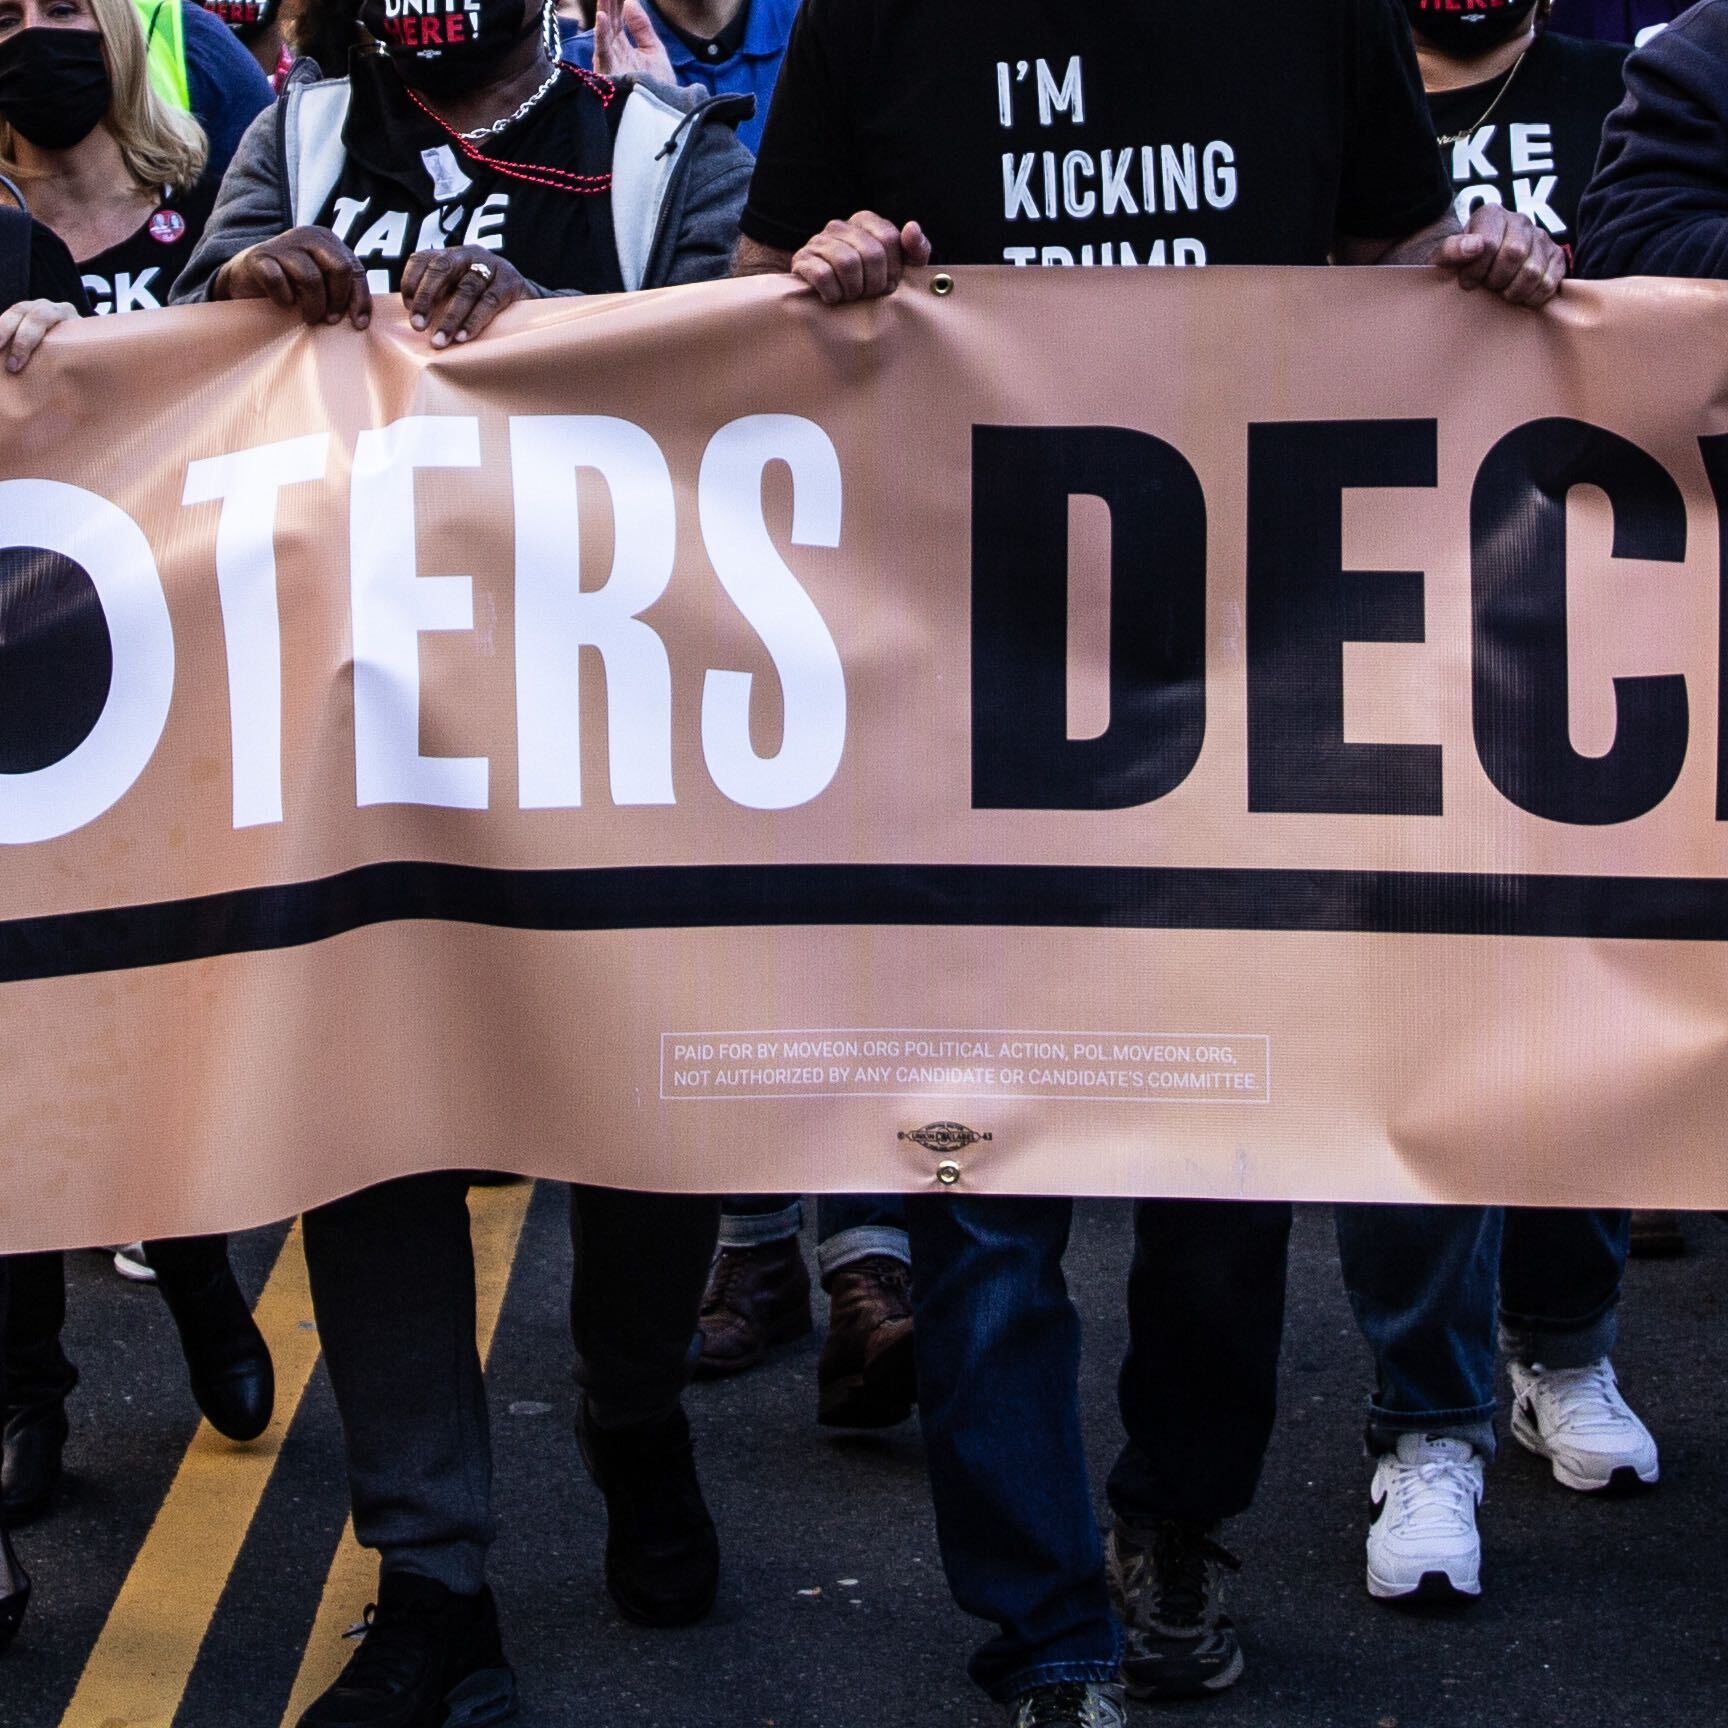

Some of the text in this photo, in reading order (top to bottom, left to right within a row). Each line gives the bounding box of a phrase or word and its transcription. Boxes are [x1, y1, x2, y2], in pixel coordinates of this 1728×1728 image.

[205, 2, 265, 23] HERE!
[383, 10, 481, 46] HERE!
[996, 55, 1085, 127] I'M
[1002, 140, 1239, 220] KICKING
[332, 193, 510, 258] TAKE
[674, 1041, 1238, 1064] PAID FOR BY MOVEON.ORG POLITICAL ACTION, POL.MOVEON.ORG,
[674, 1067, 1260, 1090] NOT AUTHORIZED BY ANY CANDIDATE OR CANDIDATE'S COMMITTEE.
